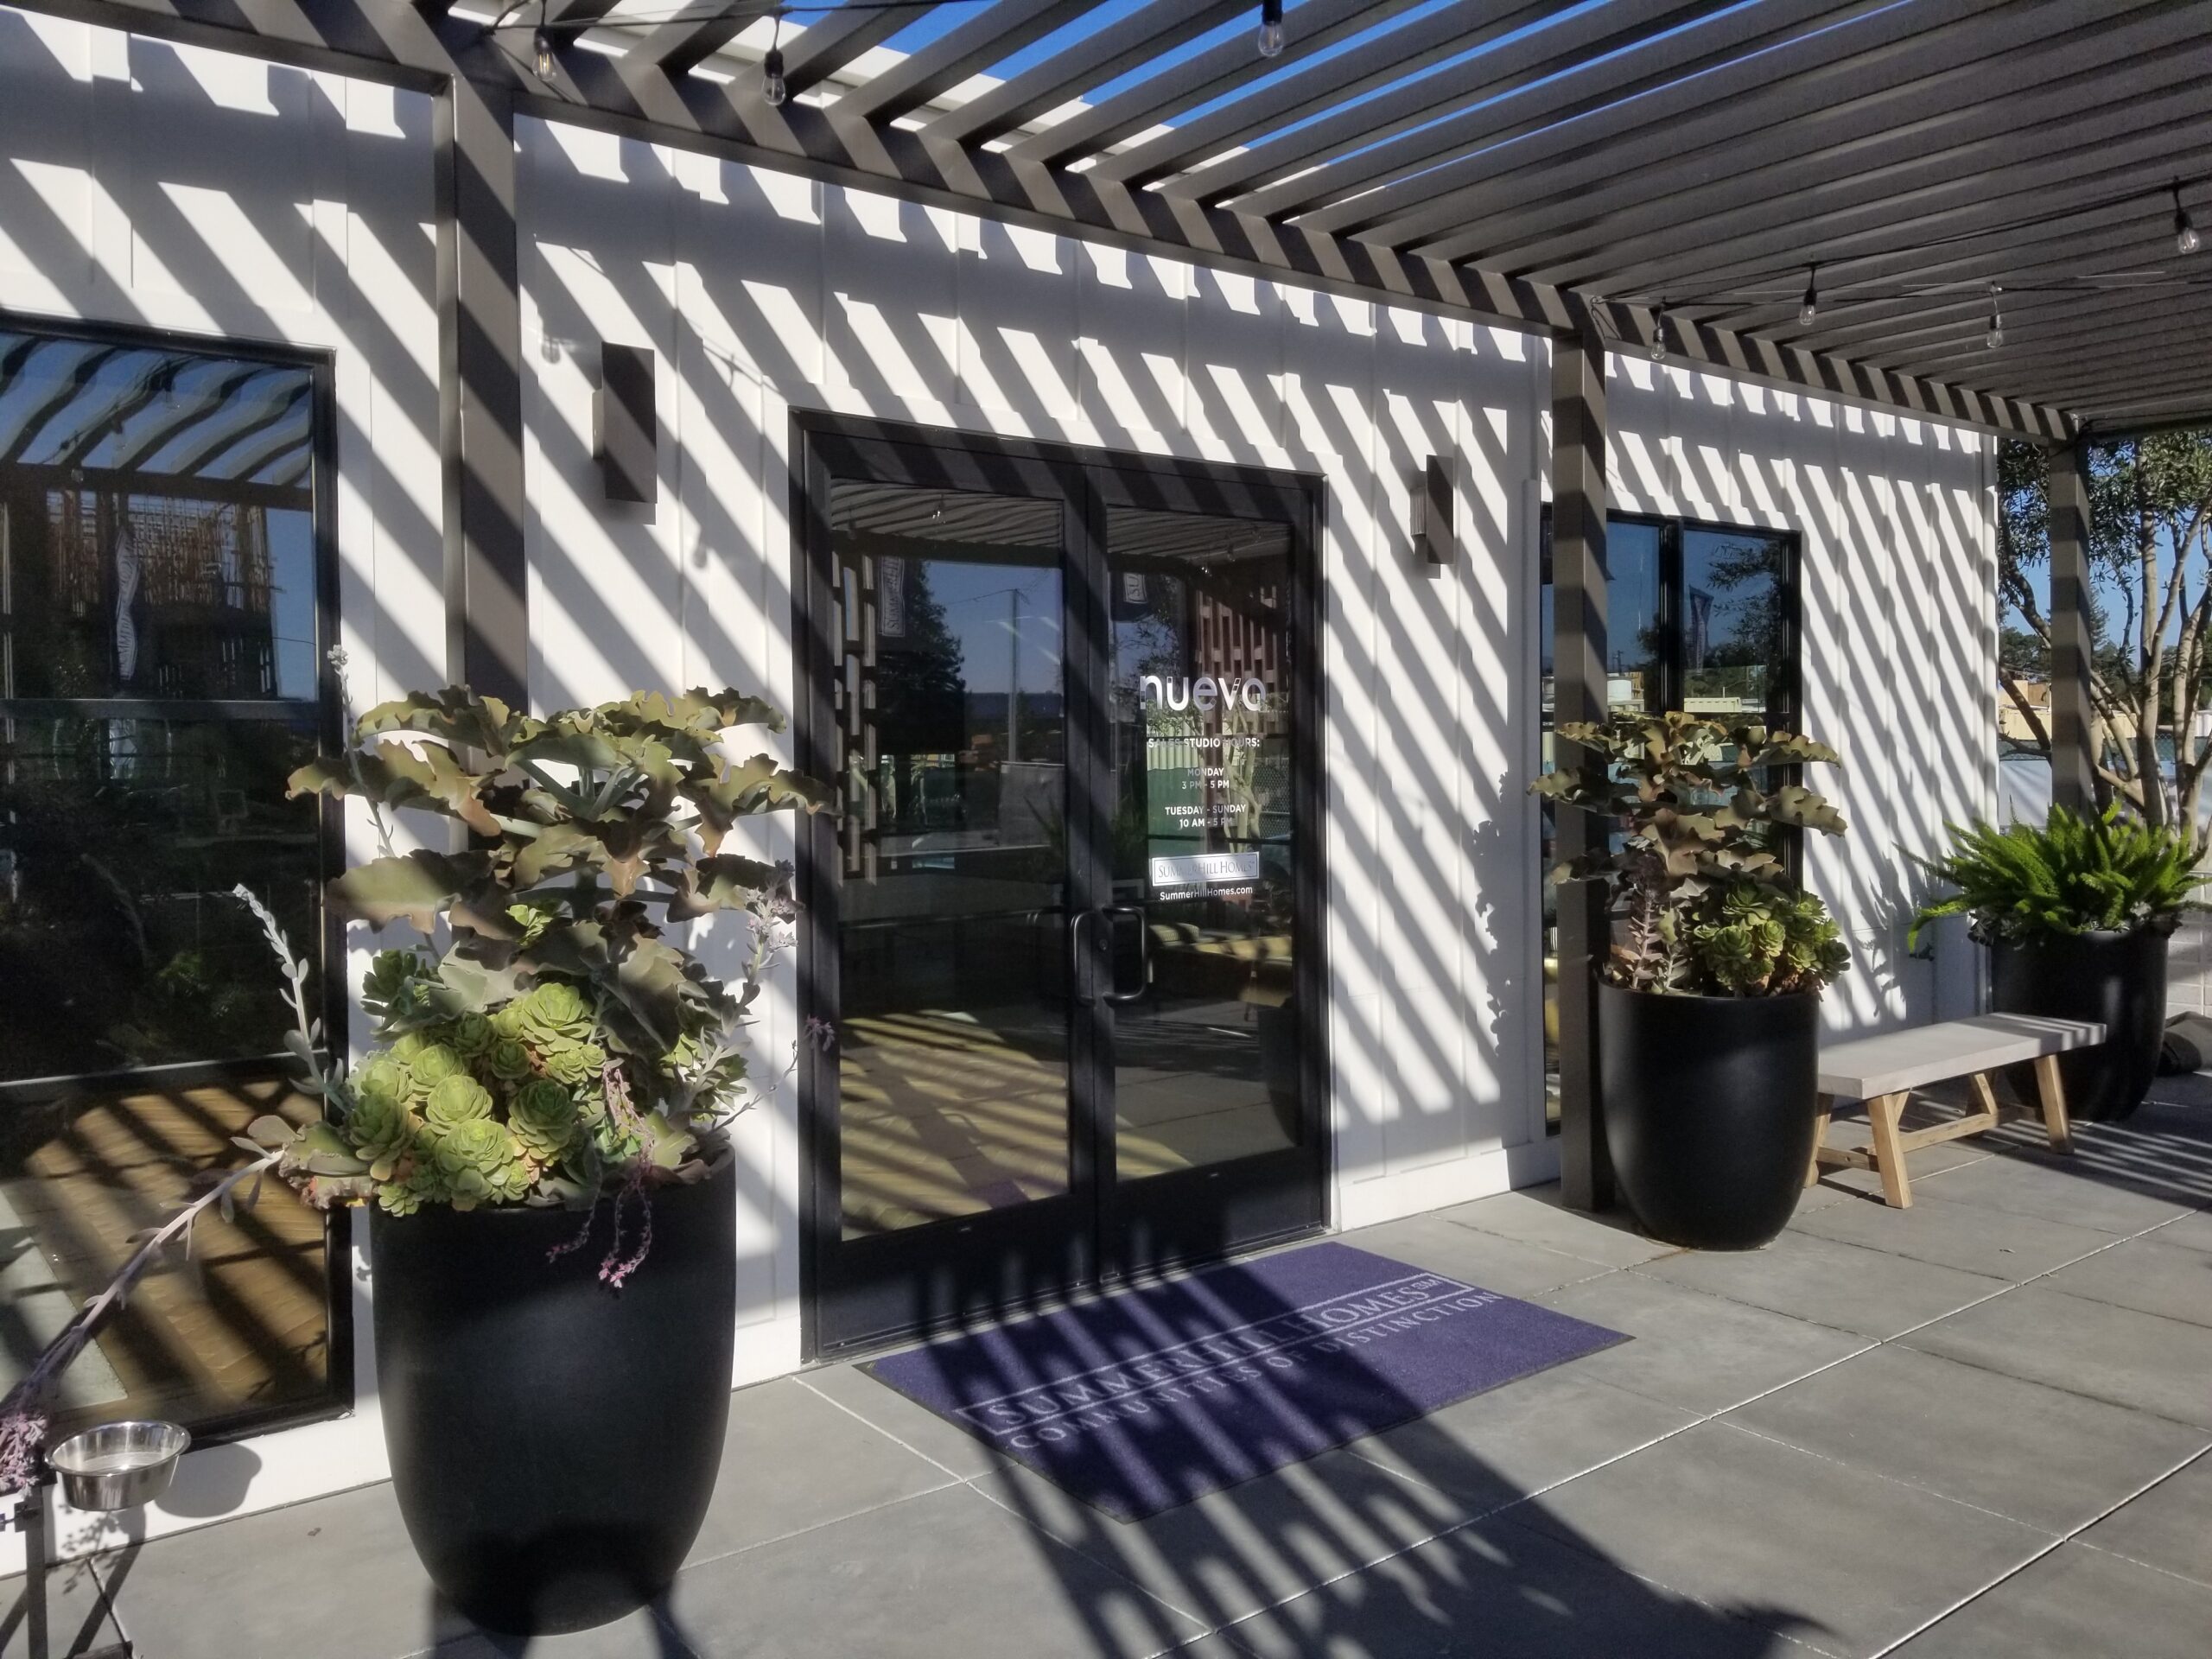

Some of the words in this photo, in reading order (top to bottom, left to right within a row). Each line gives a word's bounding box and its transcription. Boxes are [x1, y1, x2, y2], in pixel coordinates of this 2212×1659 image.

[1140, 675, 1267, 711] nueva
[1147, 738, 1183, 748] SALES
[1184, 738, 1220, 748] STUDIO
[1222, 737, 1260, 747] HOURS:
[1187, 767, 1224, 777] MONDAY
[1181, 781, 1187, 790] 3
[1189, 780, 1202, 790] PM
[1210, 780, 1216, 789] 5
[1217, 779, 1230, 789] PM
[1165, 806, 1205, 816] TUESDAY
[1212, 804, 1246, 813] SUNDAY
[1179, 818, 1189, 828] 10
[1191, 818, 1205, 827] AM
[1220, 817, 1233, 826] PM
[1160, 886, 1253, 901] SummerHillHomes.com
[1010, 1366, 1262, 1449] COMMUNITIES
[1266, 1350, 1308, 1369] OF
[1311, 1292, 1504, 1353] DISTINCTION
[988, 1329, 1295, 1425] SUMMERHILL
